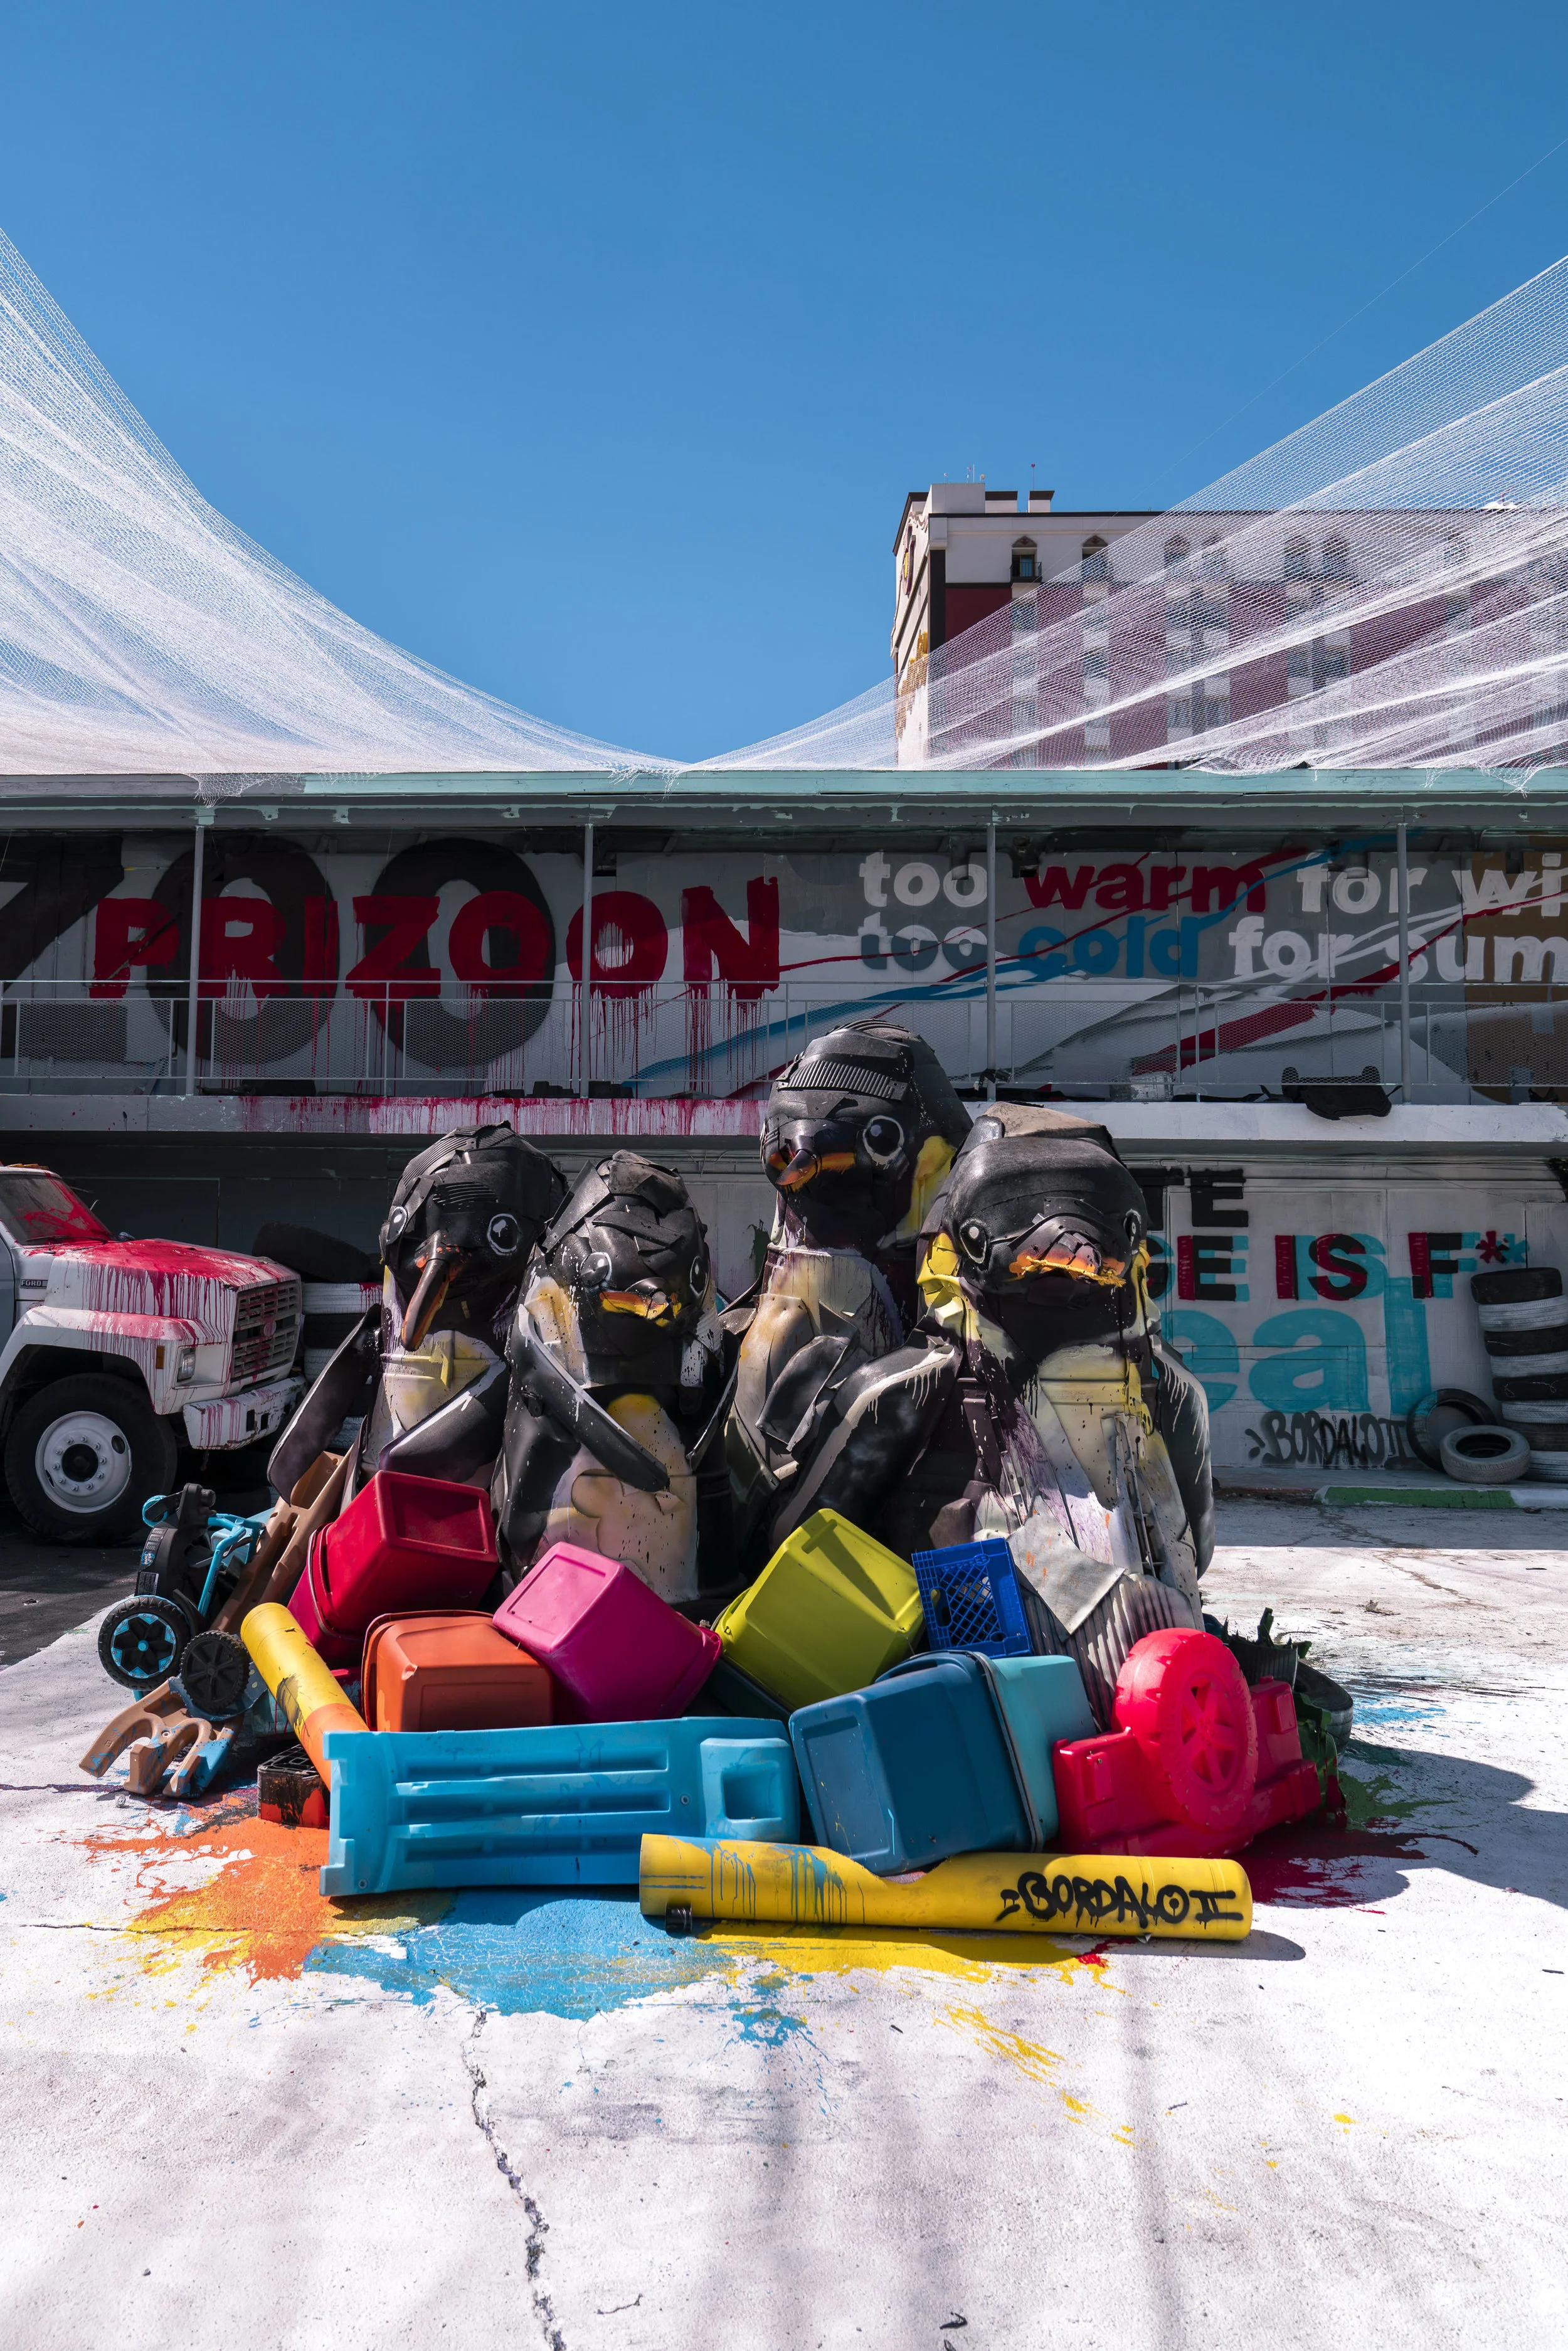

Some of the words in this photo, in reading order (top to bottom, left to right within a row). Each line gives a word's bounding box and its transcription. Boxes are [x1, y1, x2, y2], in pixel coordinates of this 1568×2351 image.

[859, 852, 988, 908] too
[1022, 863, 1266, 913] warm
[1296, 851, 1428, 915] for
[859, 912, 988, 972] too
[1017, 915, 1199, 978] cold
[1228, 916, 1354, 979] for
[1276, 1233, 1387, 1301] IS
[1261, 1410, 1385, 1469] BORDALO
[1017, 1871, 1190, 1929] BORDALO
